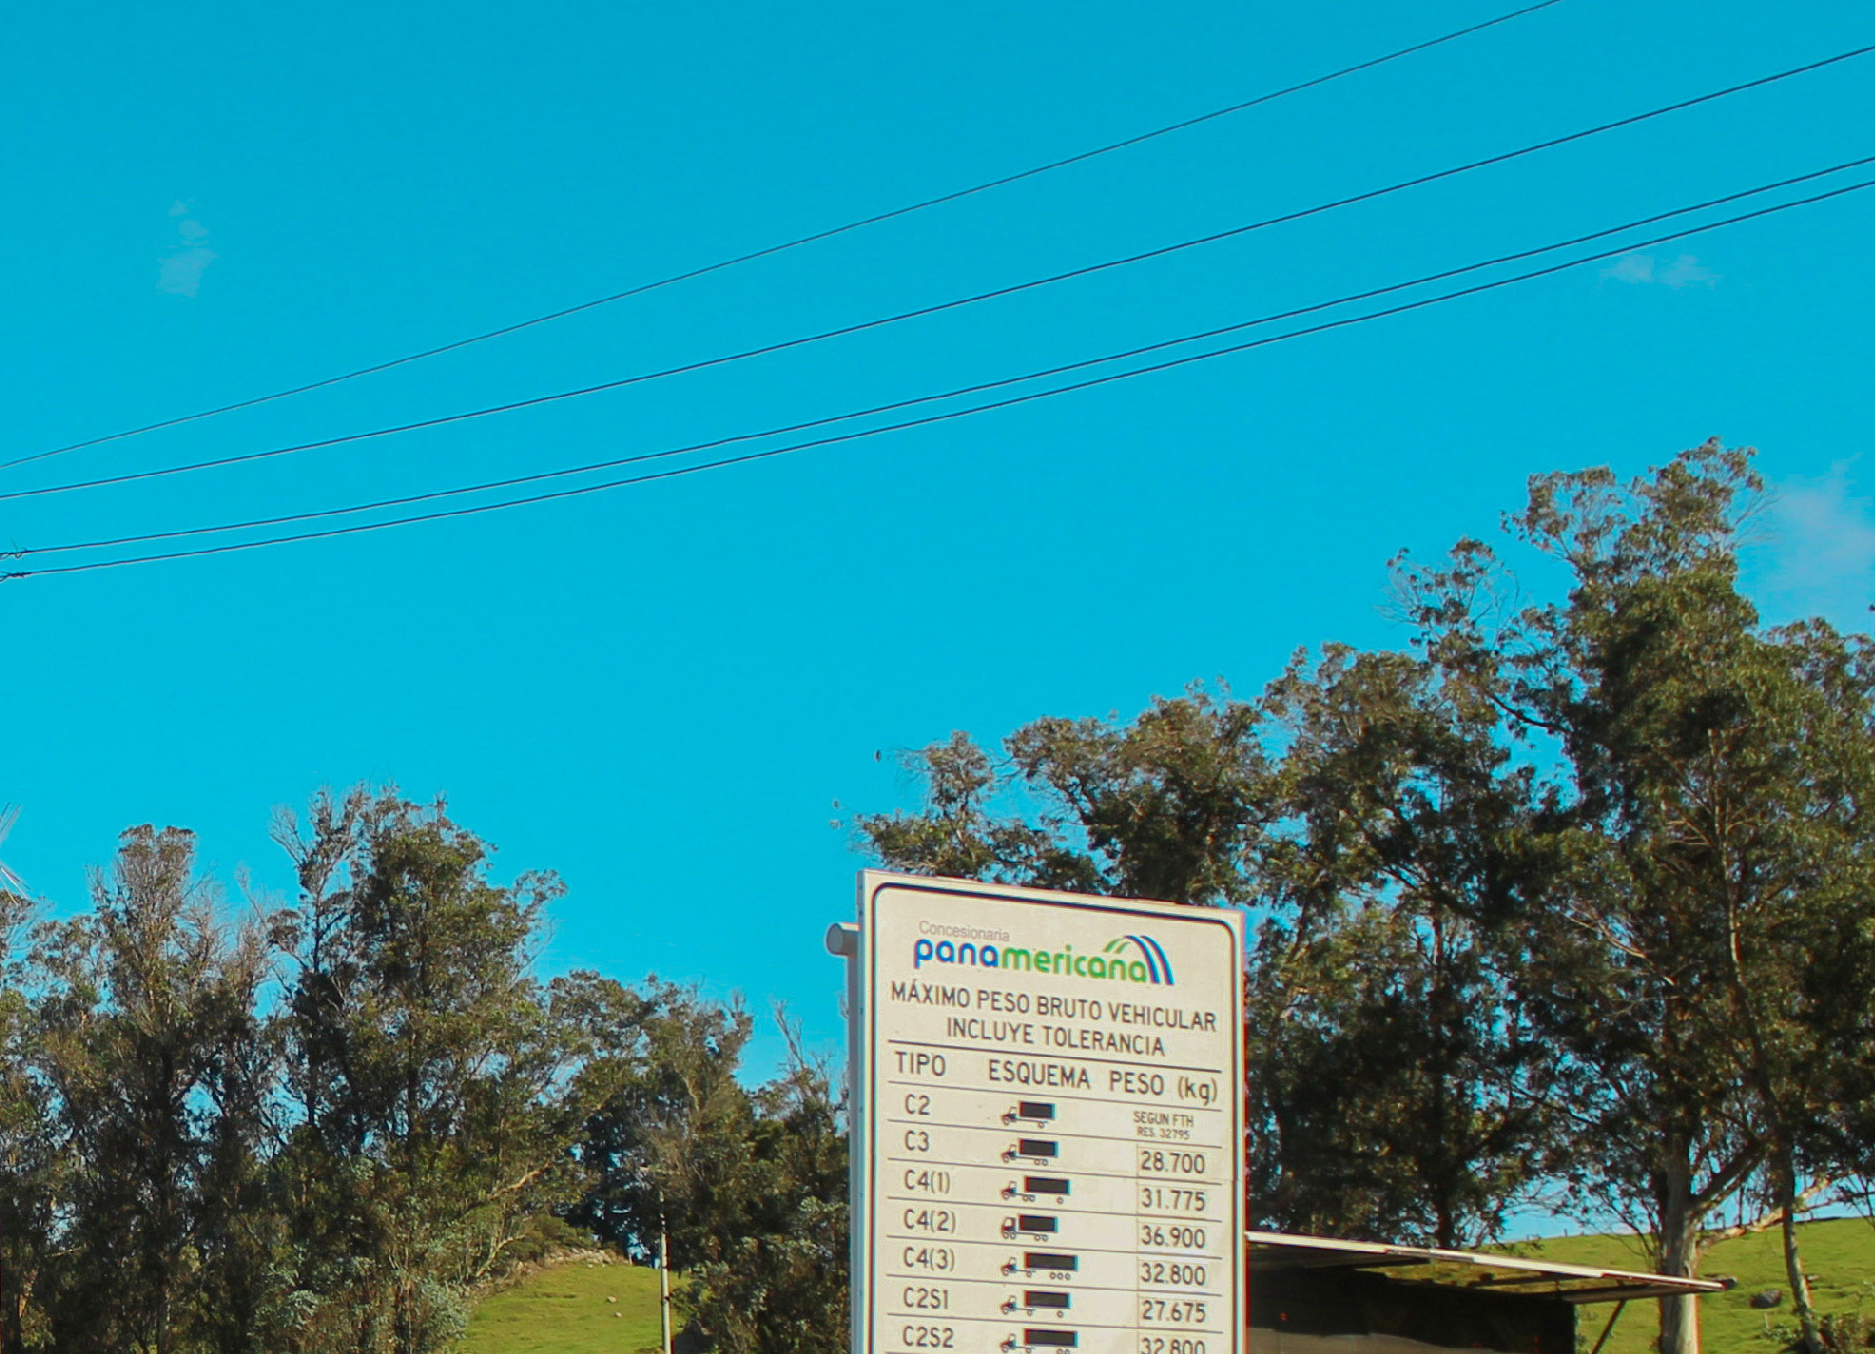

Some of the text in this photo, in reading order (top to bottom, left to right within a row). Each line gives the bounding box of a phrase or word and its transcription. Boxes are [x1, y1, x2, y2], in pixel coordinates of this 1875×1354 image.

[919, 921, 1009, 942] Concesionaria
[914, 938, 1146, 983] panamericana
[892, 979, 1216, 1034] MÁXIMO PESO BRUTO VEHICULAR
[947, 1018, 1166, 1057] INCLUYE TOLERANCIA
[895, 1051, 1219, 1106] TIPO ESQUEMA PESO (kg)
[905, 1094, 930, 1115] C2
[905, 1130, 1205, 1175] C3 28.700
[904, 1169, 1205, 1212] C4(1) 31.775
[904, 1209, 1205, 1249] C4(2) 36.900
[903, 1247, 1205, 1286] C4(3) 32.800
[903, 1287, 1205, 1323] C2S1 27.675
[903, 1326, 953, 1348] C2S2
